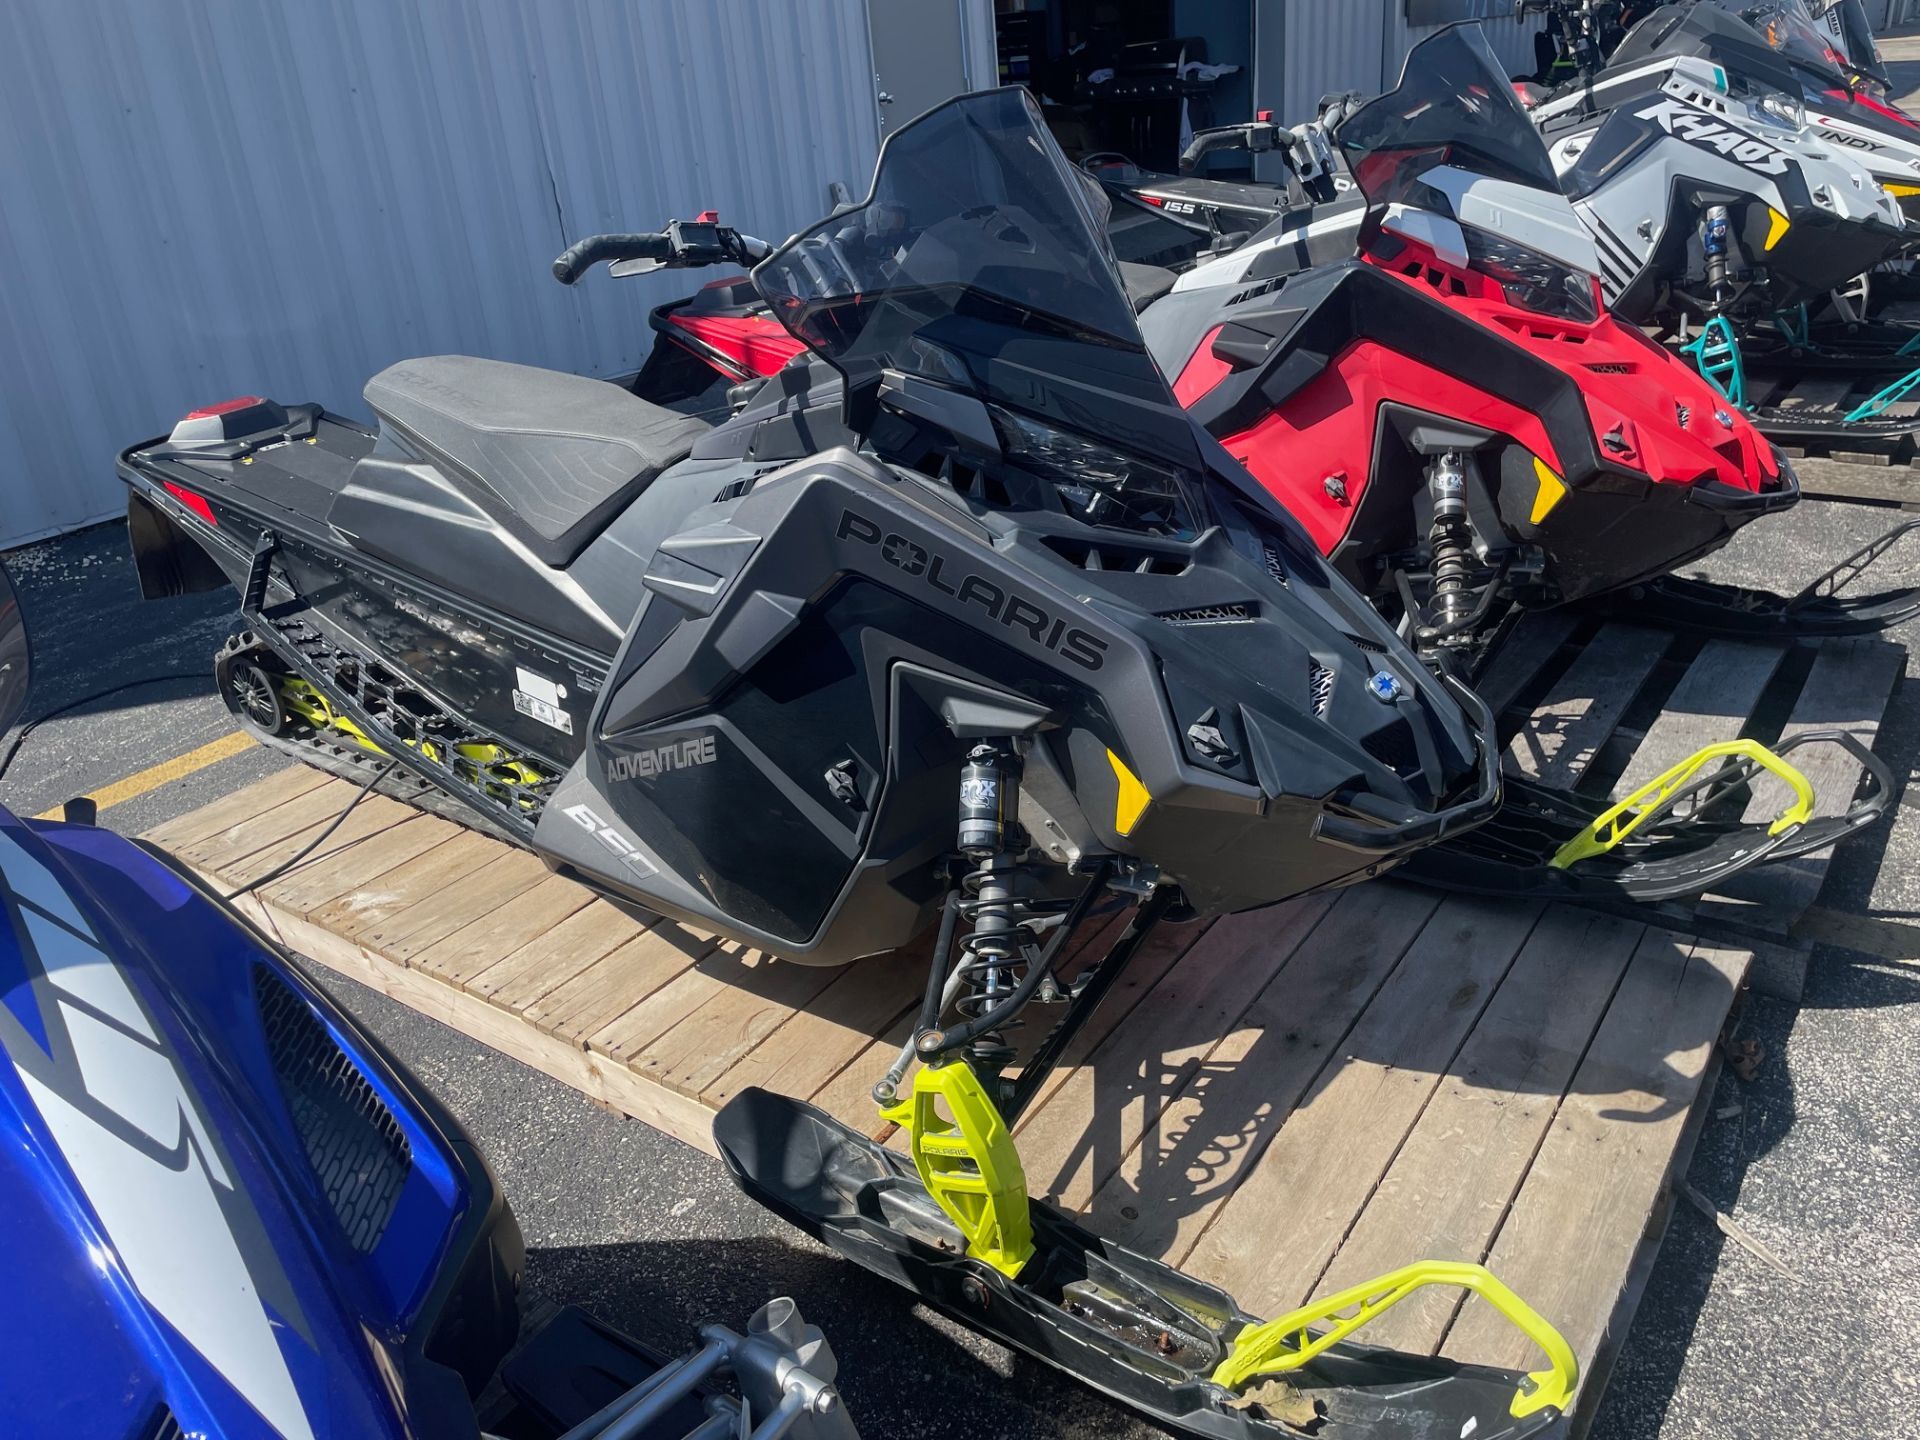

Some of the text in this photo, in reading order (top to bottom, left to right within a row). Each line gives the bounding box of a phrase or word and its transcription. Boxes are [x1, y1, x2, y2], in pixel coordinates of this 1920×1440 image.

[1634, 98, 1796, 175] KHAOS
[1819, 131, 1886, 151] INDY
[1164, 201, 1196, 214] 155
[835, 509, 1109, 672] POLARIS
[608, 735, 717, 783] ADVENTURE
[961, 779, 996, 803] FOX
[561, 803, 660, 880] 650
[922, 1145, 969, 1156] POLARIS
